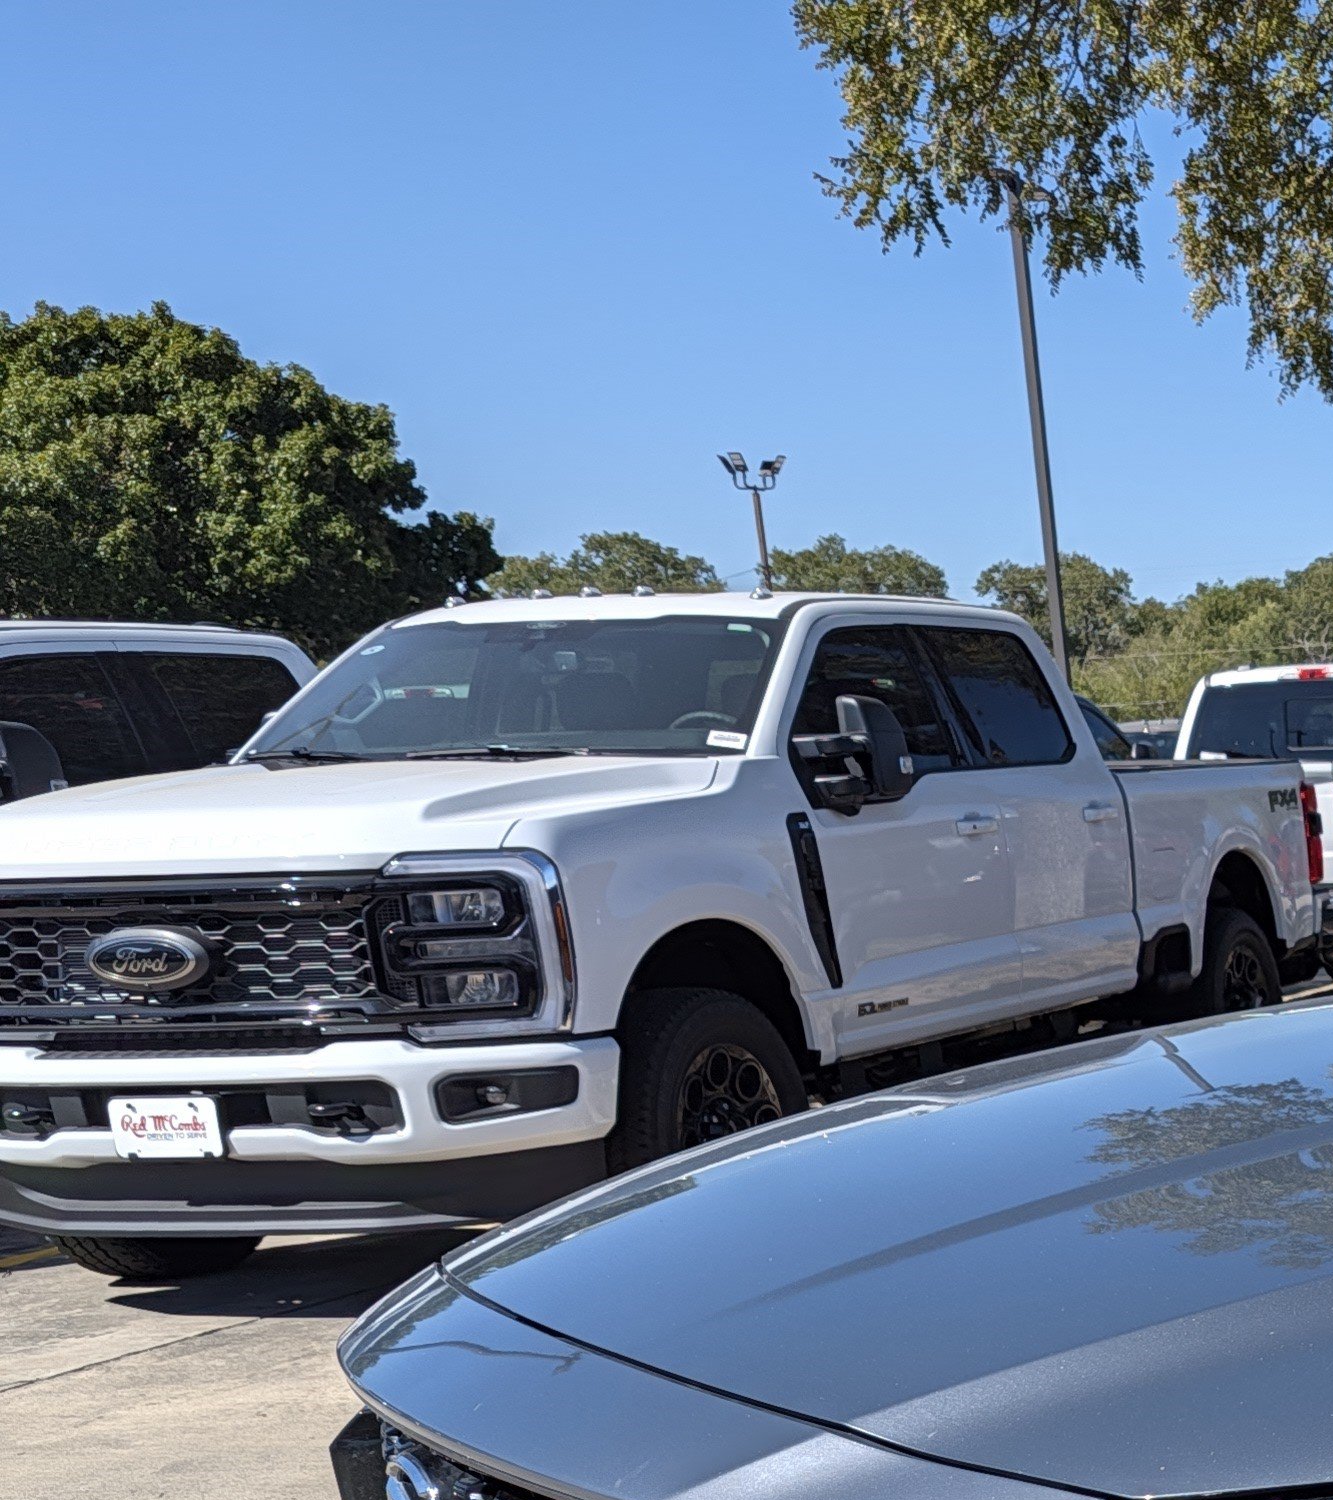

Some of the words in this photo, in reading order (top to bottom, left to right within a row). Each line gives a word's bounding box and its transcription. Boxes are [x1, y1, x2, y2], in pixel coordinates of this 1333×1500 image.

[1268, 788, 1298, 812] FX4
[112, 947, 168, 973] Ford
[121, 1114, 148, 1138] Red
[149, 1114, 207, 1131] McCombs
[147, 1132, 173, 1140] DRIVEN
